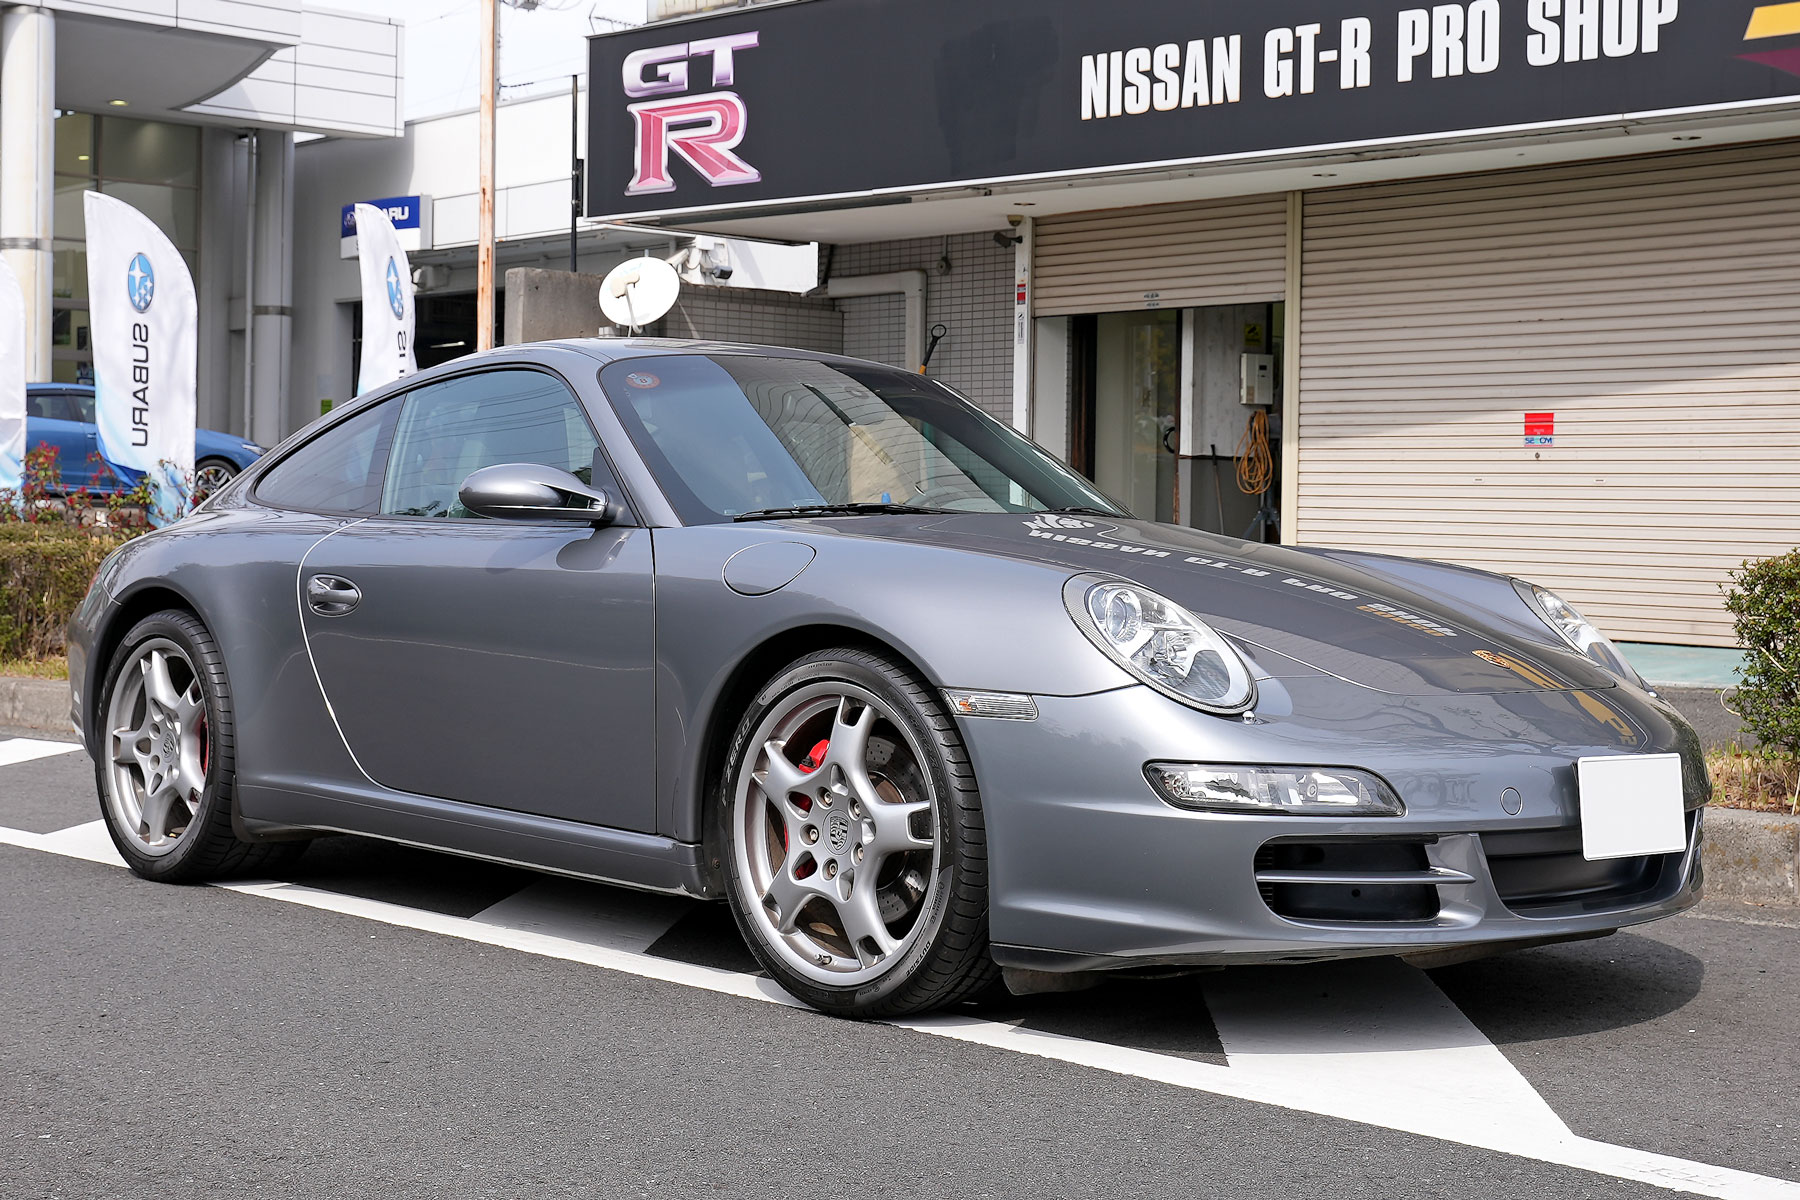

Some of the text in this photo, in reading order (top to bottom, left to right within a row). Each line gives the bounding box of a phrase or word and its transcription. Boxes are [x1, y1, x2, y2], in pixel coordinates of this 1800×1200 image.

[622, 31, 760, 98] GT
[1081, 0, 1679, 121] NISSAN GT-R PRO SHOP
[624, 90, 762, 197] R
